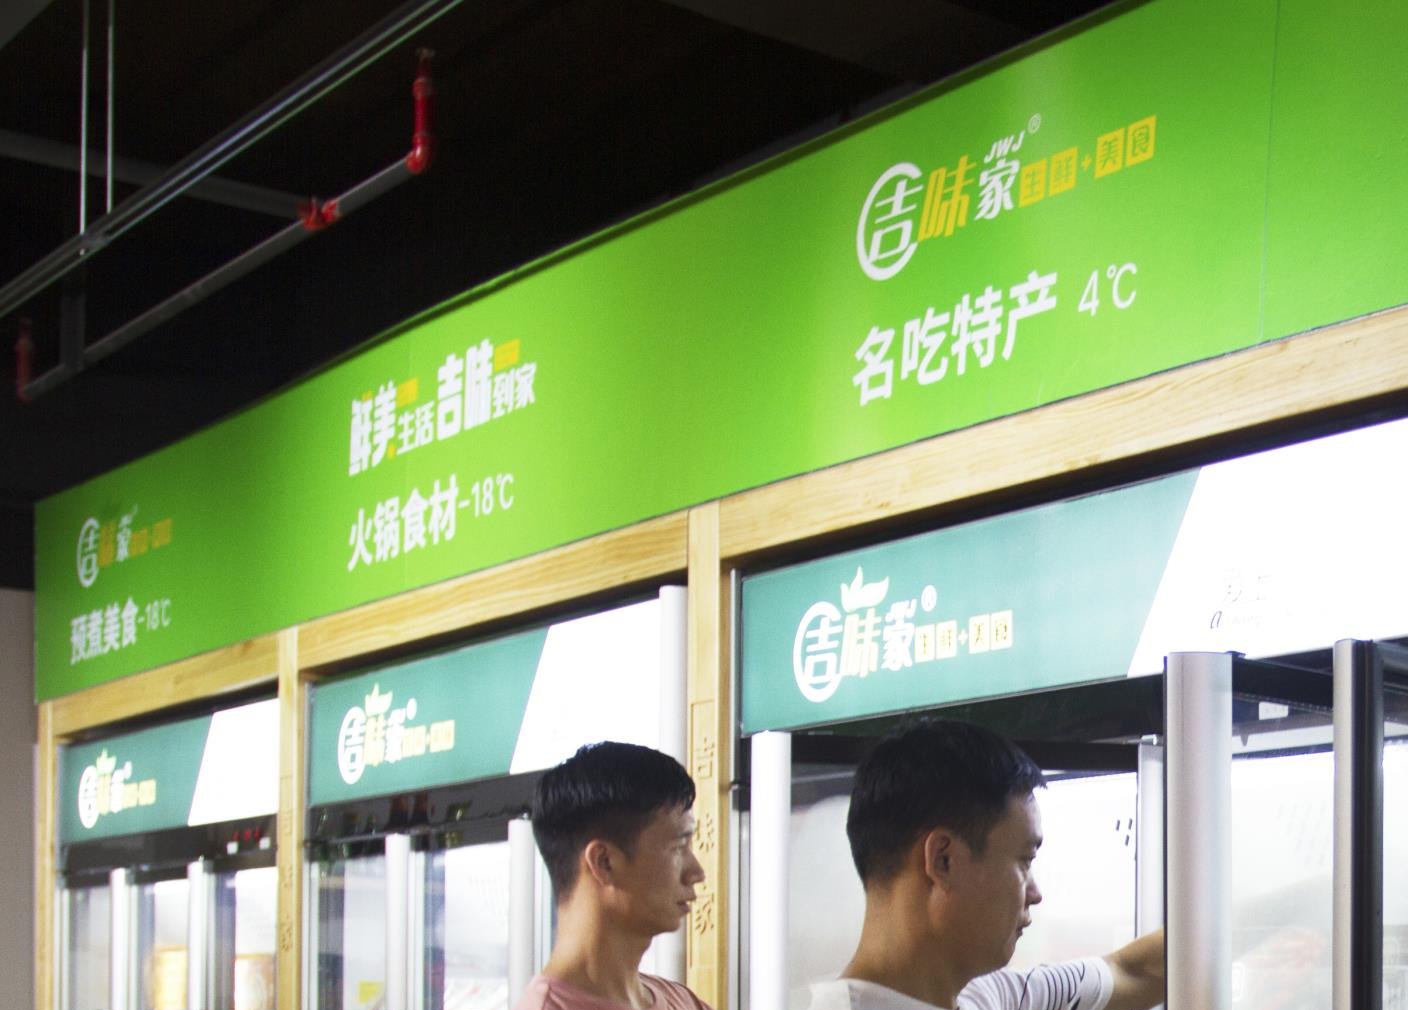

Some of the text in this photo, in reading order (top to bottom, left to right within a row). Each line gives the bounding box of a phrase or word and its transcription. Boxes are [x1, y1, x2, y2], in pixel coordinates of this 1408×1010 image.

[984, 131, 1025, 163] JWJ
[856, 155, 1021, 281] 吉味家
[852, 262, 1138, 406] 名吃特产 4℃
[793, 602, 916, 703] 吉味家
